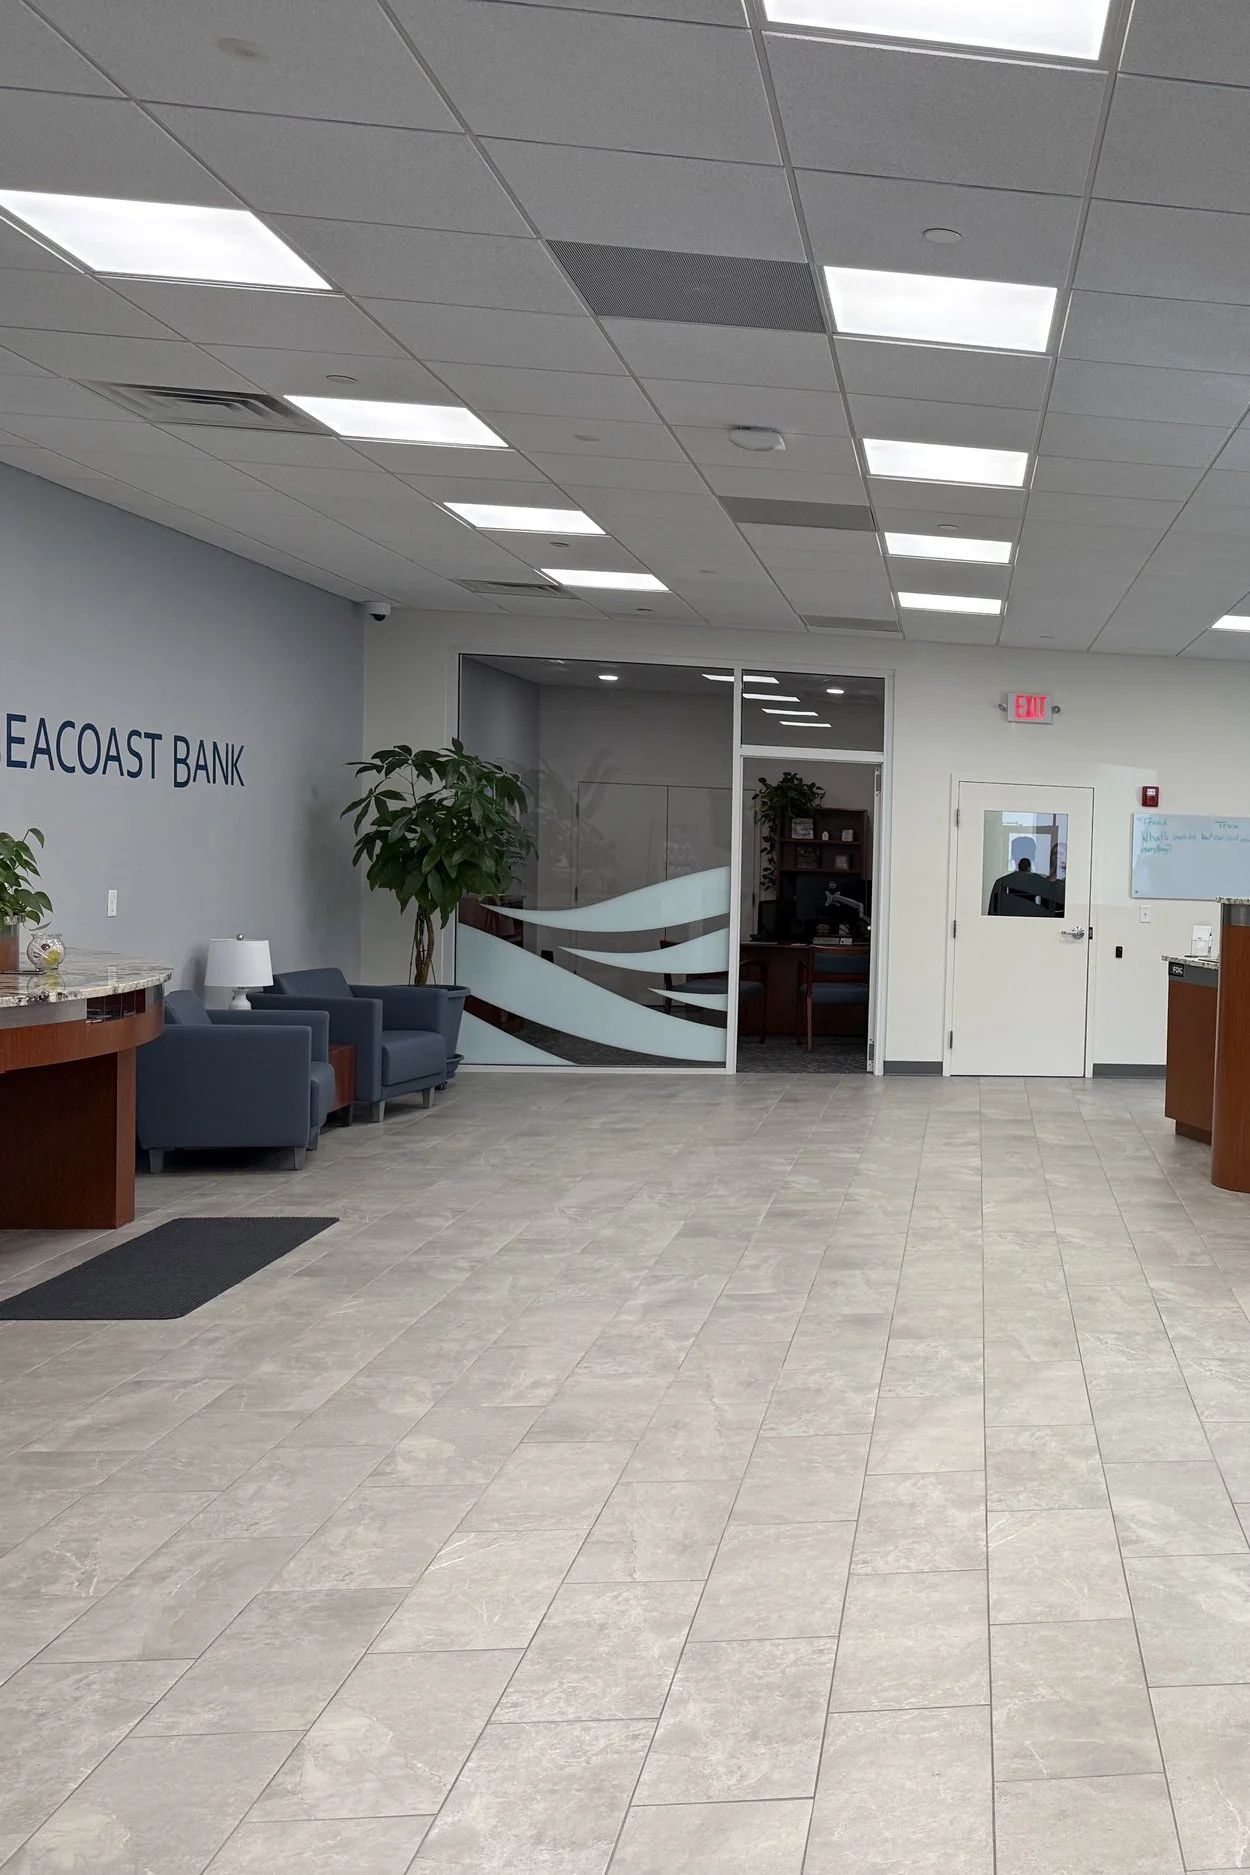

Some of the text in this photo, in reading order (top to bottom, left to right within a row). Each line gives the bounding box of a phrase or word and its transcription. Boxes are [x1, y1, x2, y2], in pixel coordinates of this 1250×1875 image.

[1015, 694, 1048, 720] EXIT
[0, 713, 245, 788] EACOAST BANK
